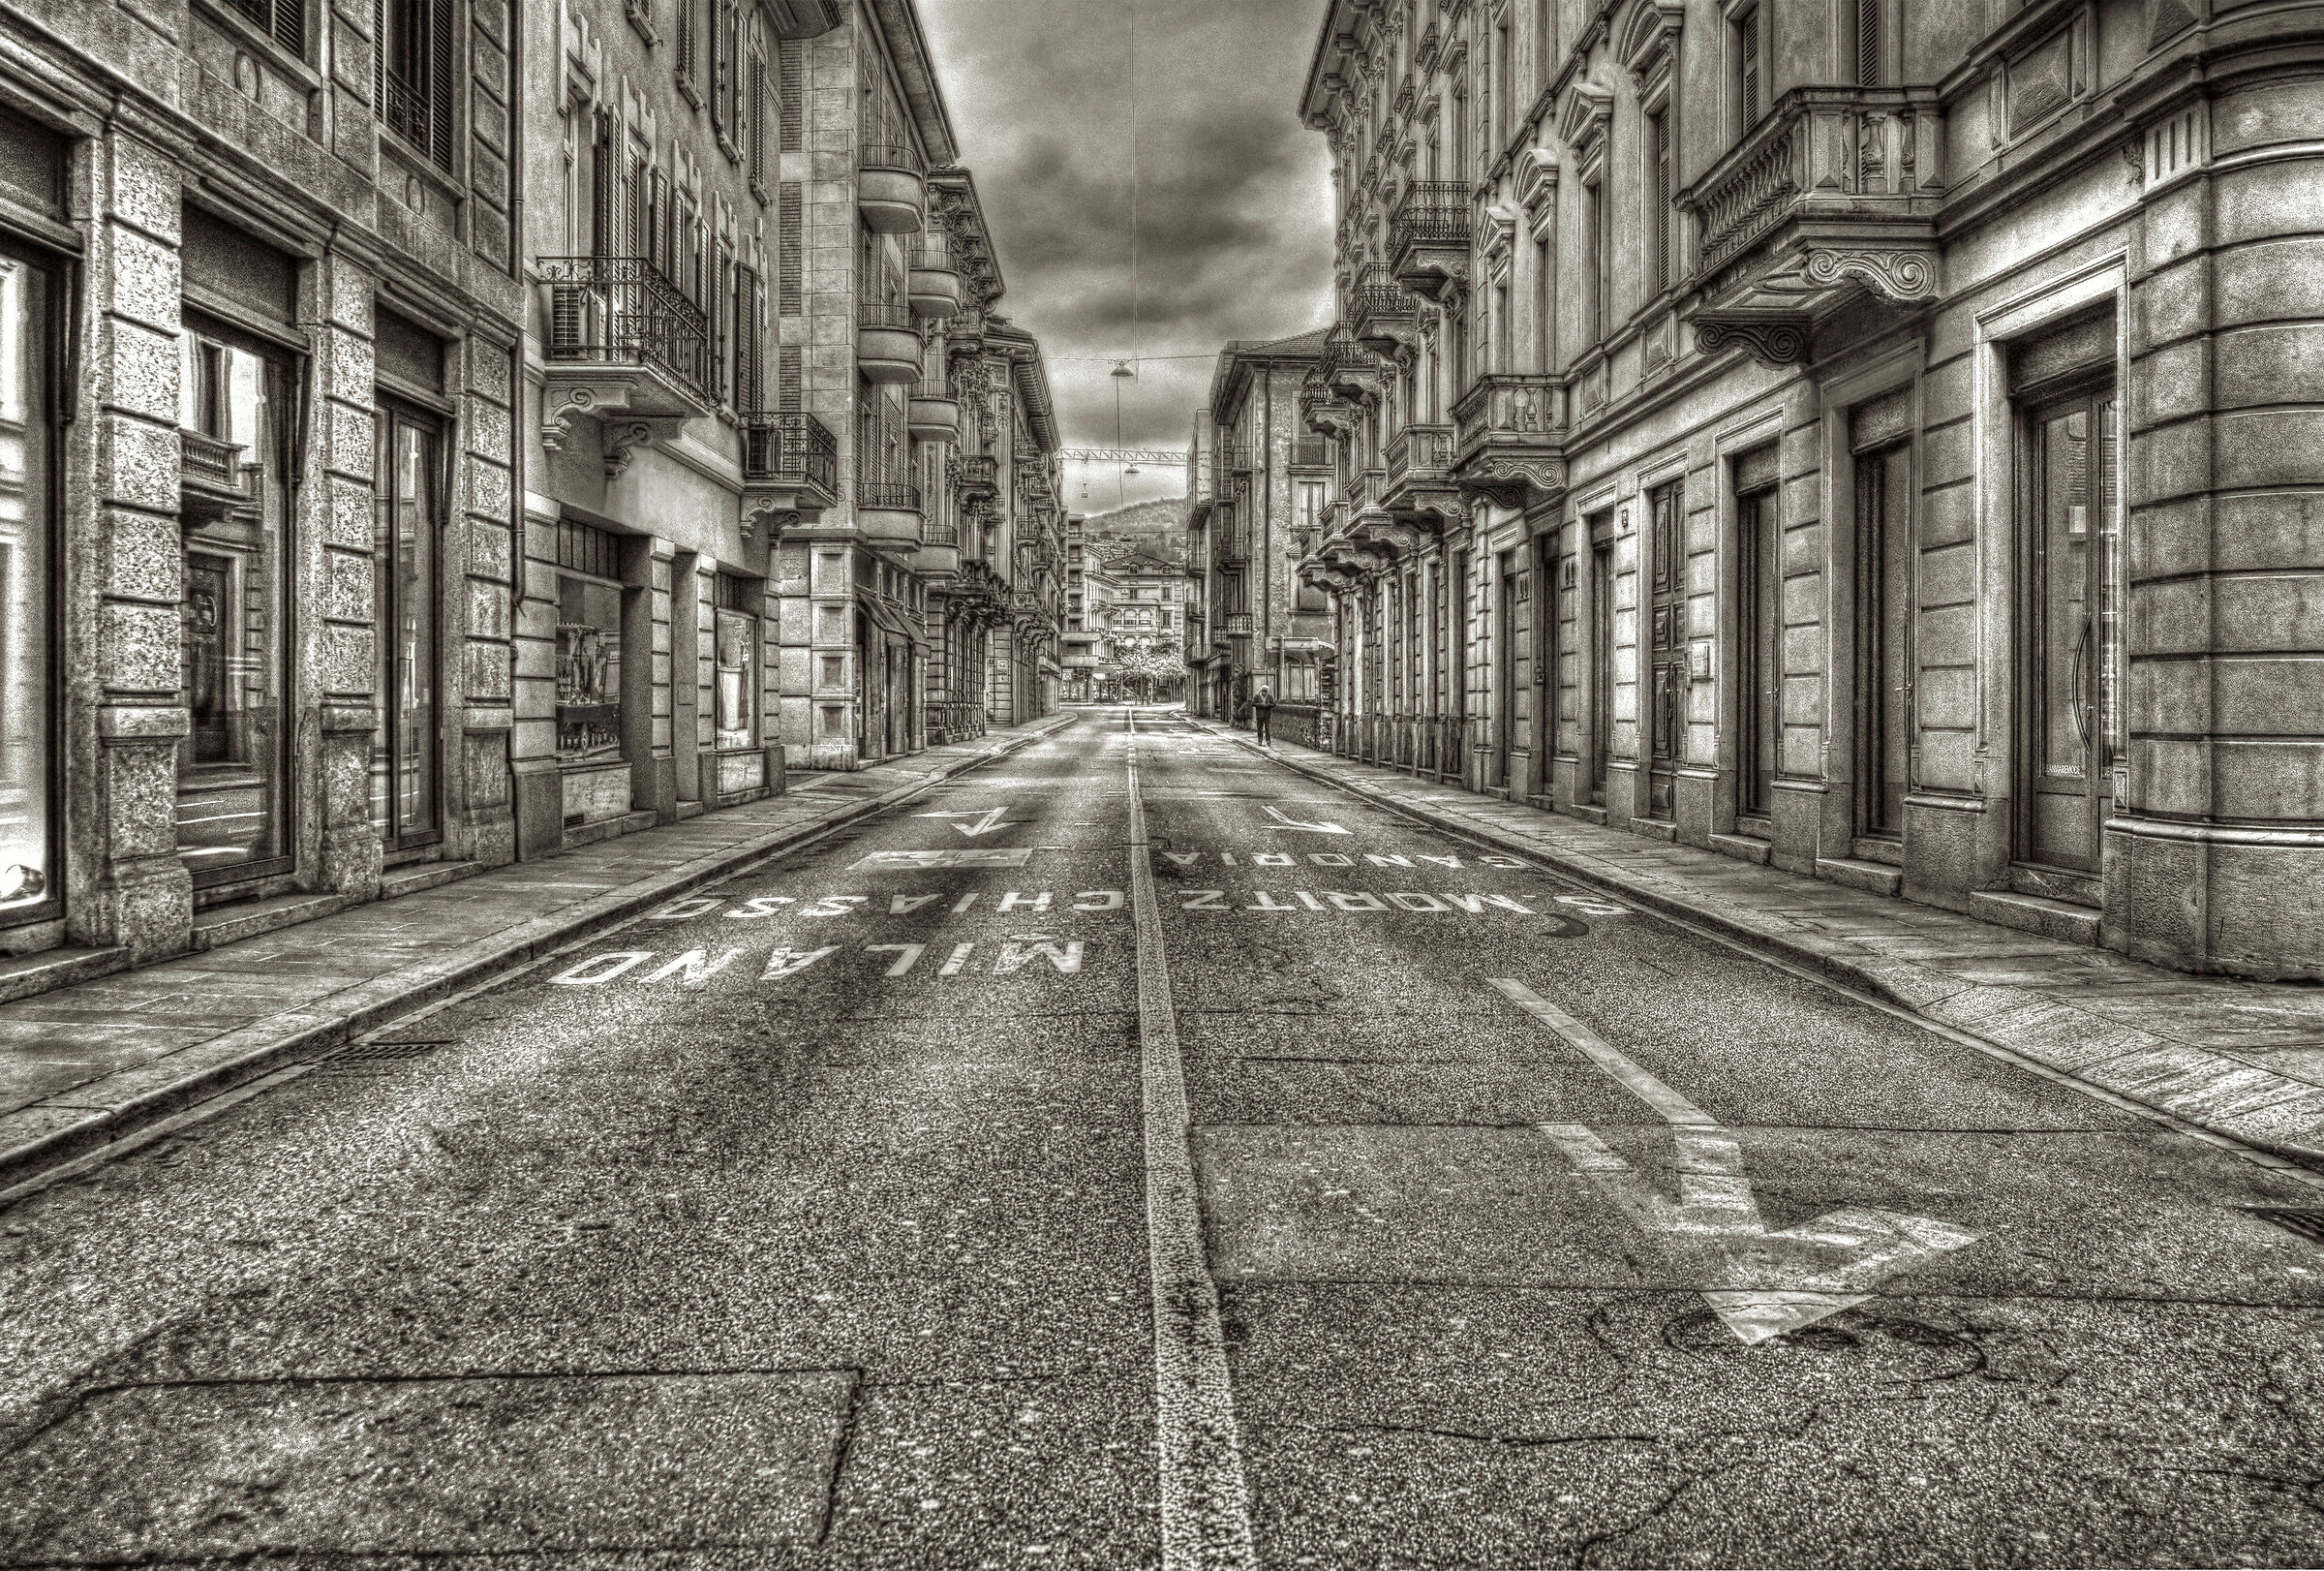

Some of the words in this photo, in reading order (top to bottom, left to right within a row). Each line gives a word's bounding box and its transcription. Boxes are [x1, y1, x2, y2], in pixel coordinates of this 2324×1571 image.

[1163, 852, 1530, 869] GANDRIA
[650, 891, 1124, 918] CHIASSO
[546, 941, 1086, 985] MILANO
